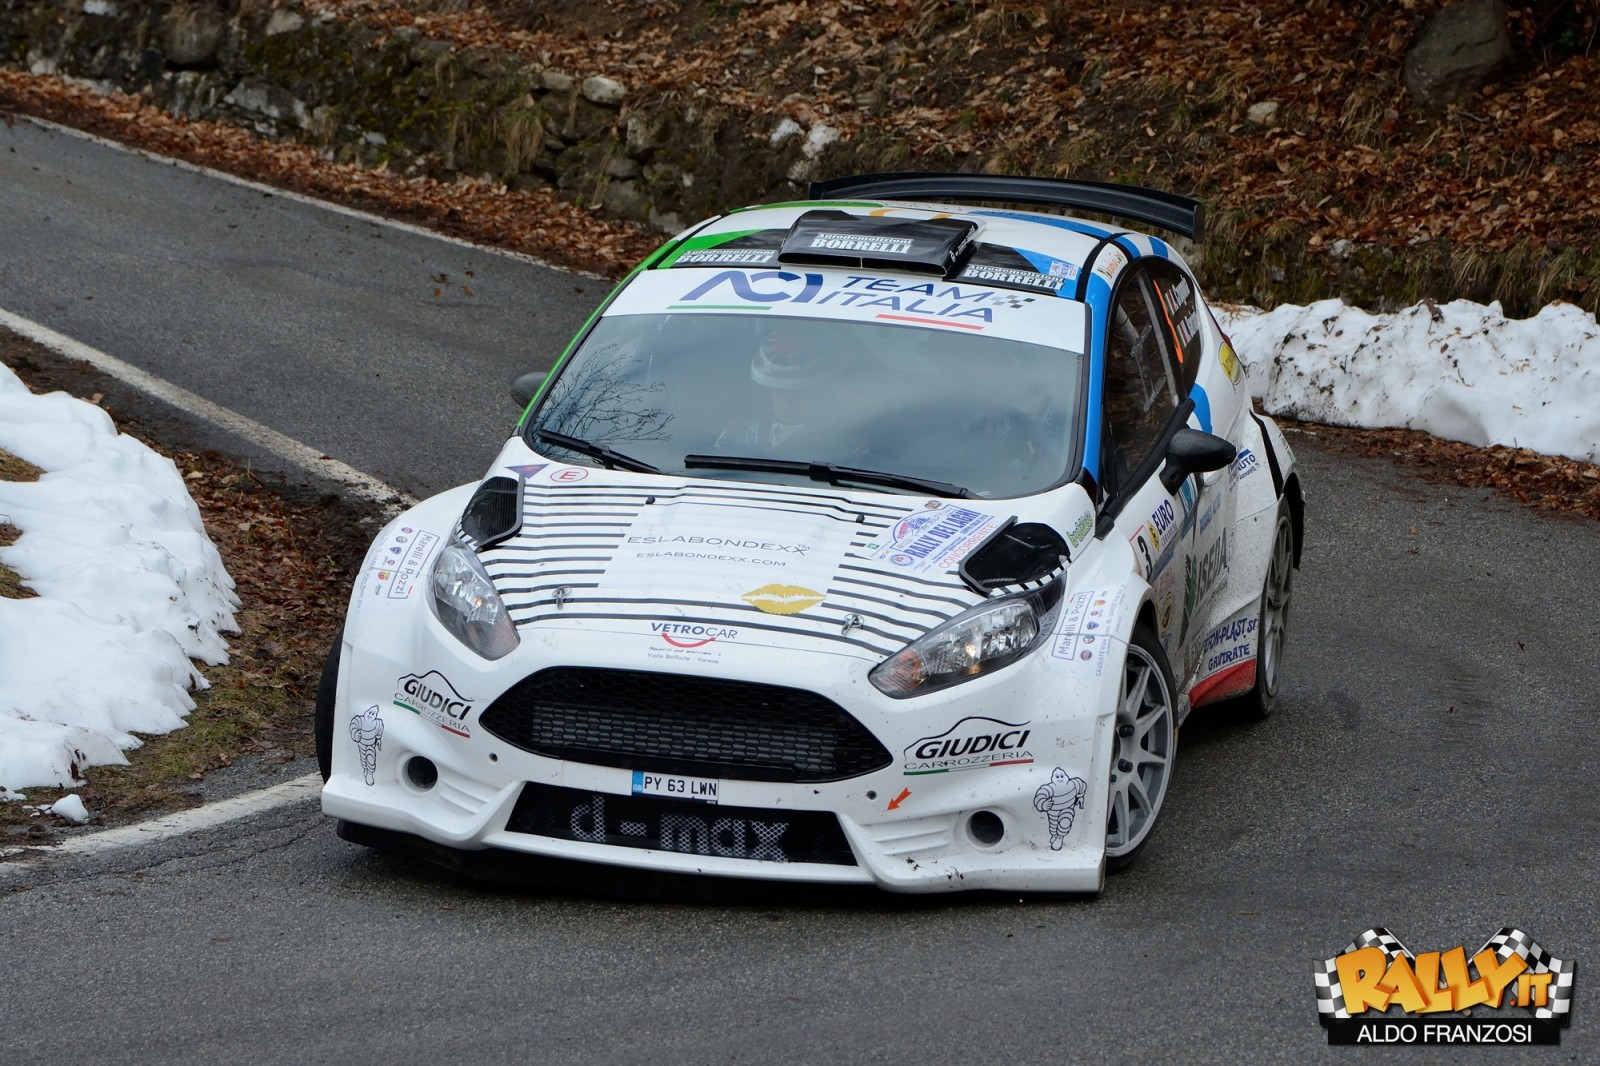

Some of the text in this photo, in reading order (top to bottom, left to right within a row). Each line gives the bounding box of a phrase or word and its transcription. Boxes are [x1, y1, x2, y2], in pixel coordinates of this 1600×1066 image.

[675, 254, 774, 263] BORRELLI
[810, 239, 912, 254] BORRELLI
[679, 270, 824, 303] ACI
[839, 275, 995, 302] TEAM
[816, 291, 993, 322] ITALIA
[559, 471, 580, 480] E
[1151, 498, 1175, 536] EURO
[411, 534, 434, 560] Marelli
[627, 535, 808, 556] ESLABONDEXX
[903, 534, 943, 559] RALLY
[928, 521, 959, 540] DEI
[946, 508, 982, 529] LAGHI
[938, 523, 998, 569] CONCORRENTE
[636, 551, 787, 567] ESLABONDEXX.COM
[1137, 535, 1153, 582] 3
[394, 567, 414, 594] Pozzi
[651, 622, 738, 639] VETROCAR
[1058, 624, 1077, 655] Marelli
[1072, 594, 1088, 616] Pozzi
[648, 652, 663, 660] Viale
[666, 653, 691, 662] Belforte
[698, 656, 719, 664] Varese
[1208, 643, 1250, 671] GAVIRATE
[394, 692, 470, 733] CARROZZERIA
[404, 679, 472, 720] GIUDICI
[915, 730, 1031, 759] GIUDICI
[903, 750, 1034, 770] CARROZZERIA
[644, 776, 717, 796] PY 63 LWN
[570, 794, 790, 863] d-max
